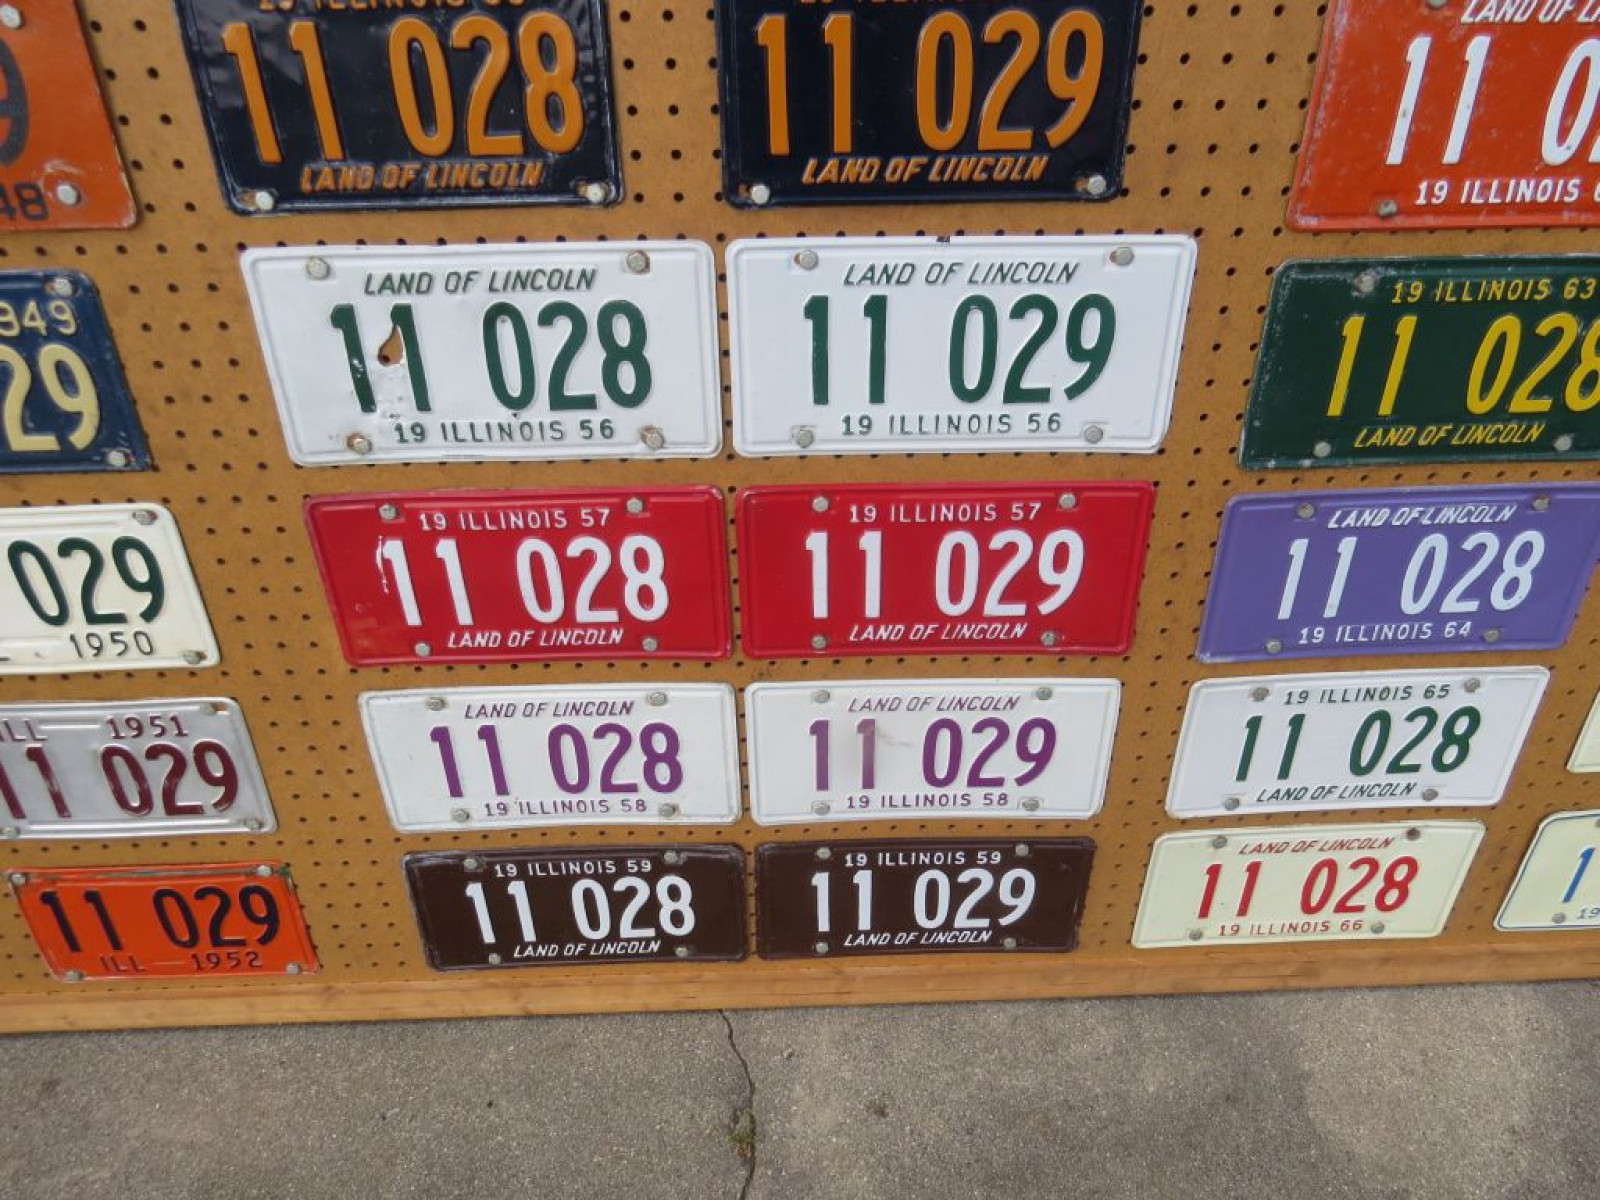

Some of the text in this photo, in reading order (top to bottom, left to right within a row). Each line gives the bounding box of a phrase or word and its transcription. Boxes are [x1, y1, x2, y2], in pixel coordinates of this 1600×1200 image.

[1461, 0, 1538, 23] LAND
[1538, 0, 1575, 23] OF
[222, 13, 585, 163] 11 028
[757, 11, 1103, 155] 11 029
[1386, 35, 1491, 164] 11
[301, 160, 543, 193] LAND OF LINCOLN
[802, 155, 1049, 184] LAND OF LINCOLN
[1415, 180, 1448, 205] 19
[1461, 179, 1580, 203] ILLINOIS
[364, 268, 597, 295] LAND OF LINCOLN
[843, 262, 1080, 287] LAND OF LINCOLN
[1391, 278, 1594, 303] 19 ILLINOIS 63
[330, 299, 652, 412] 11 028
[803, 294, 1116, 405] 11 029
[1327, 313, 1600, 416] 11 028
[394, 419, 614, 443] 19 ILLINOIS 56
[841, 413, 1061, 435] 19 ILLINOIS 56
[1354, 425, 1545, 447] LAND OF LINCOLN
[419, 510, 610, 530] 19 ILLINOIS 57
[849, 503, 1042, 522] 19 ILLINOIS 57
[1328, 505, 1517, 528] LAND OF LINCOLN
[8, 536, 164, 625] 029
[382, 536, 669, 625] 11 028
[805, 529, 1084, 618] 11 029
[1278, 530, 1545, 619] 11 028
[448, 629, 624, 648] LAND OF LINCOLN
[849, 622, 1028, 641] LAND OF LINCOLN
[1299, 621, 1472, 644] 19 ILLINOIS 64
[70, 631, 153, 658] 1950
[848, 696, 1021, 712] LAND OF LINCOLN
[1285, 683, 1451, 705] 19 ILLINOIS 65
[465, 700, 634, 719] LAND OF LINCOLN
[107, 715, 188, 739] 1951
[809, 717, 1057, 791] 11 029
[1236, 705, 1481, 781] 11 028
[430, 722, 683, 797] 11 028
[102, 740, 238, 817] 029
[847, 793, 1009, 809] 19 ILLINOIS 58
[1256, 782, 1417, 803] LAND OF LINCOLN
[484, 800, 648, 816] 19 ILLINOIS 58
[1239, 837, 1396, 855] LAND OF LINCOLN
[495, 860, 652, 878] 19 ILLINOIS 59
[845, 851, 1001, 867] 19 ILLINOIS 59
[1198, 856, 1418, 918] 11 028
[466, 875, 695, 943] 11 028
[812, 869, 1036, 932] 11 029
[40, 886, 279, 951] 11 029
[1219, 919, 1363, 936] 19 ILLINOIS 66
[514, 940, 661, 958] LAND OF LINCOLN
[844, 930, 992, 946] LAND OF LINCOLN
[100, 951, 262, 972] ILL 1952
